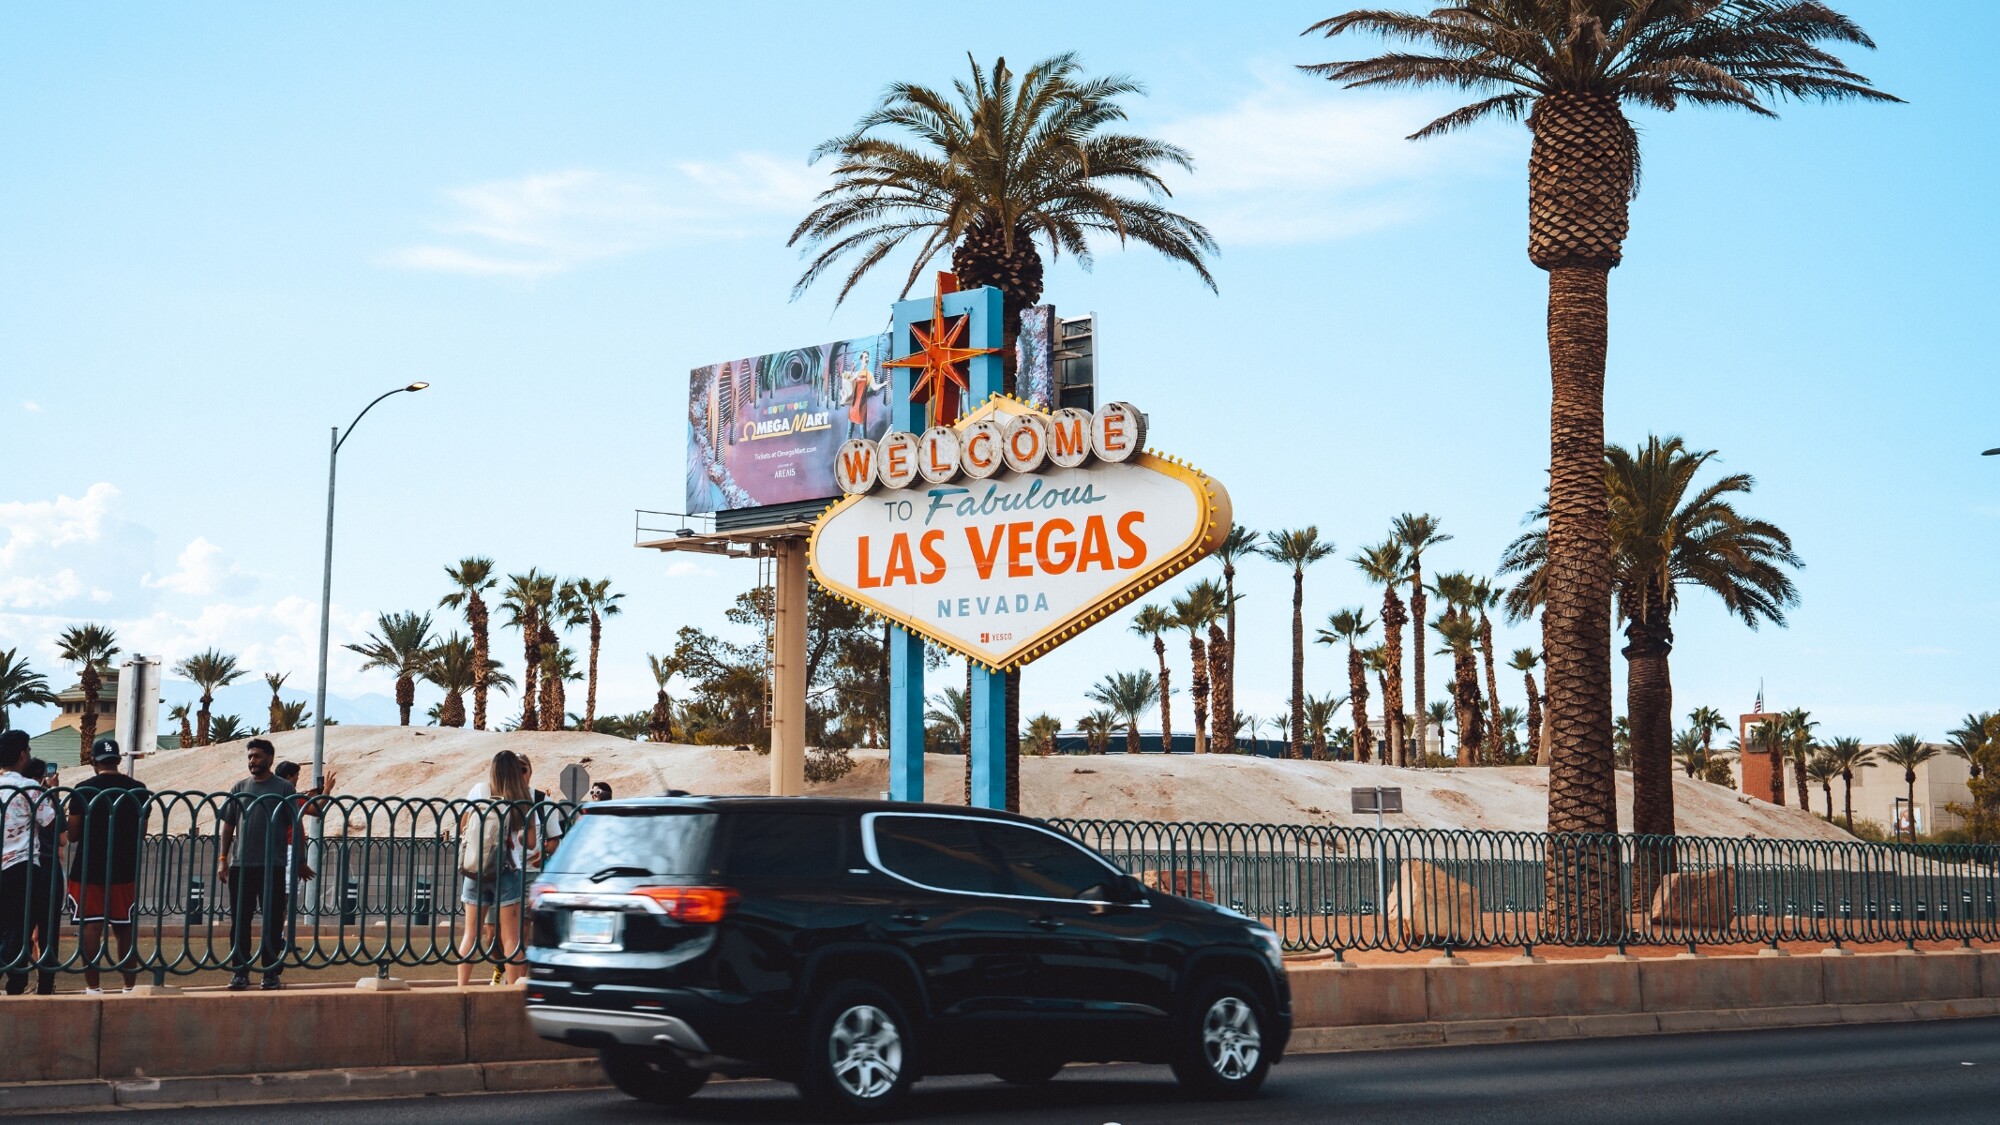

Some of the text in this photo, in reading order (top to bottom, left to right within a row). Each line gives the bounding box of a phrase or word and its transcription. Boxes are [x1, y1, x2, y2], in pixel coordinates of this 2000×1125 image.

[786, 401, 808, 411] WOLF
[844, 414, 1126, 485] WELCOME
[884, 479, 1106, 526] TO Fabulous
[857, 511, 1147, 589] LAS VEGAS
[937, 592, 1049, 618] NEVADA
[992, 633, 1012, 641] YESCO
